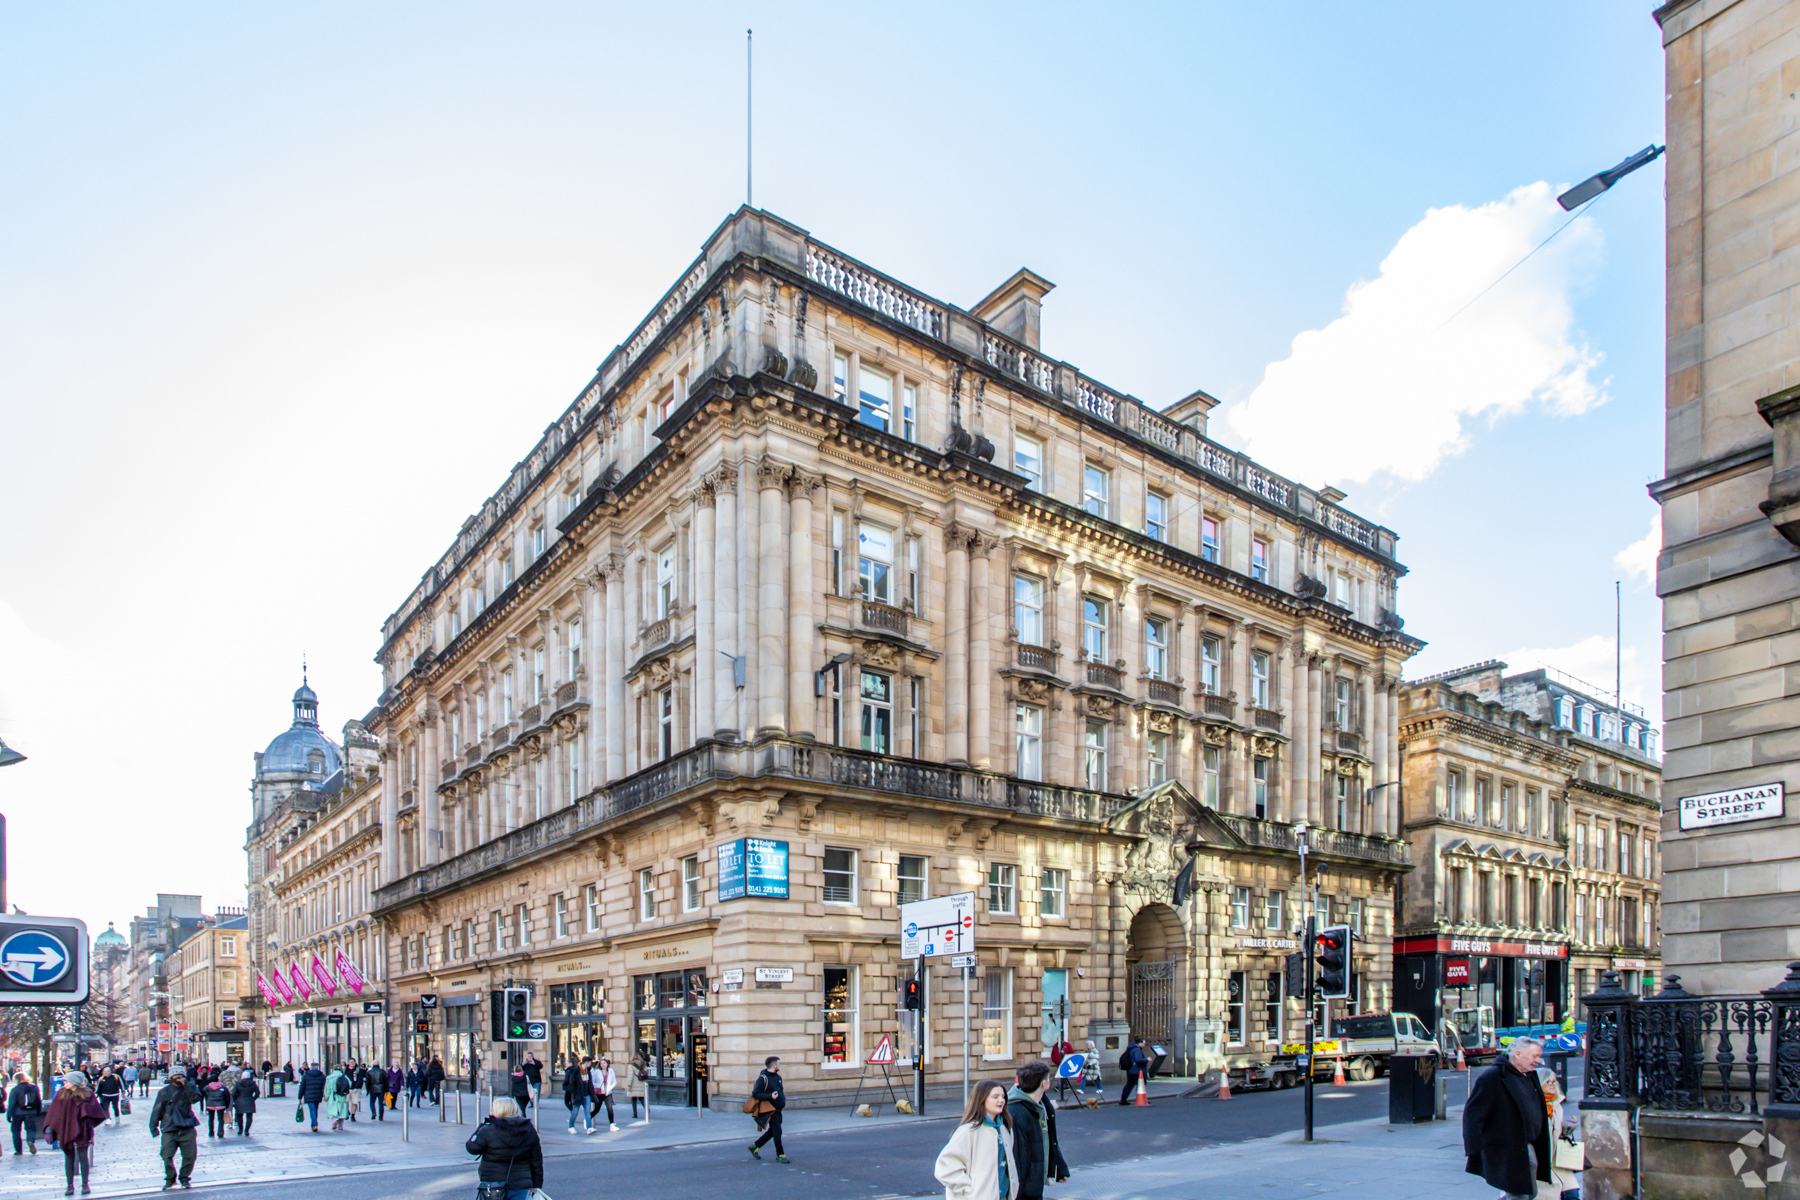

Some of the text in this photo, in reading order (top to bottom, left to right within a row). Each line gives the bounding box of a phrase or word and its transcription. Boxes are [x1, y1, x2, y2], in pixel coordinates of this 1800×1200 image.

[1683, 787, 1779, 810] BUCHANAN
[1696, 801, 1766, 819] STREET
[760, 839, 776, 848] Knight
[720, 853, 742, 869] TO LET
[747, 853, 785, 866] TO LET
[762, 886, 773, 894] 221
[773, 886, 787, 894] 9191
[950, 895, 969, 903] Through
[1242, 938, 1296, 949] MILLER & CARTER
[1451, 940, 1491, 953] FIVE GUYS
[1525, 944, 1558, 956] FIVE GUYS
